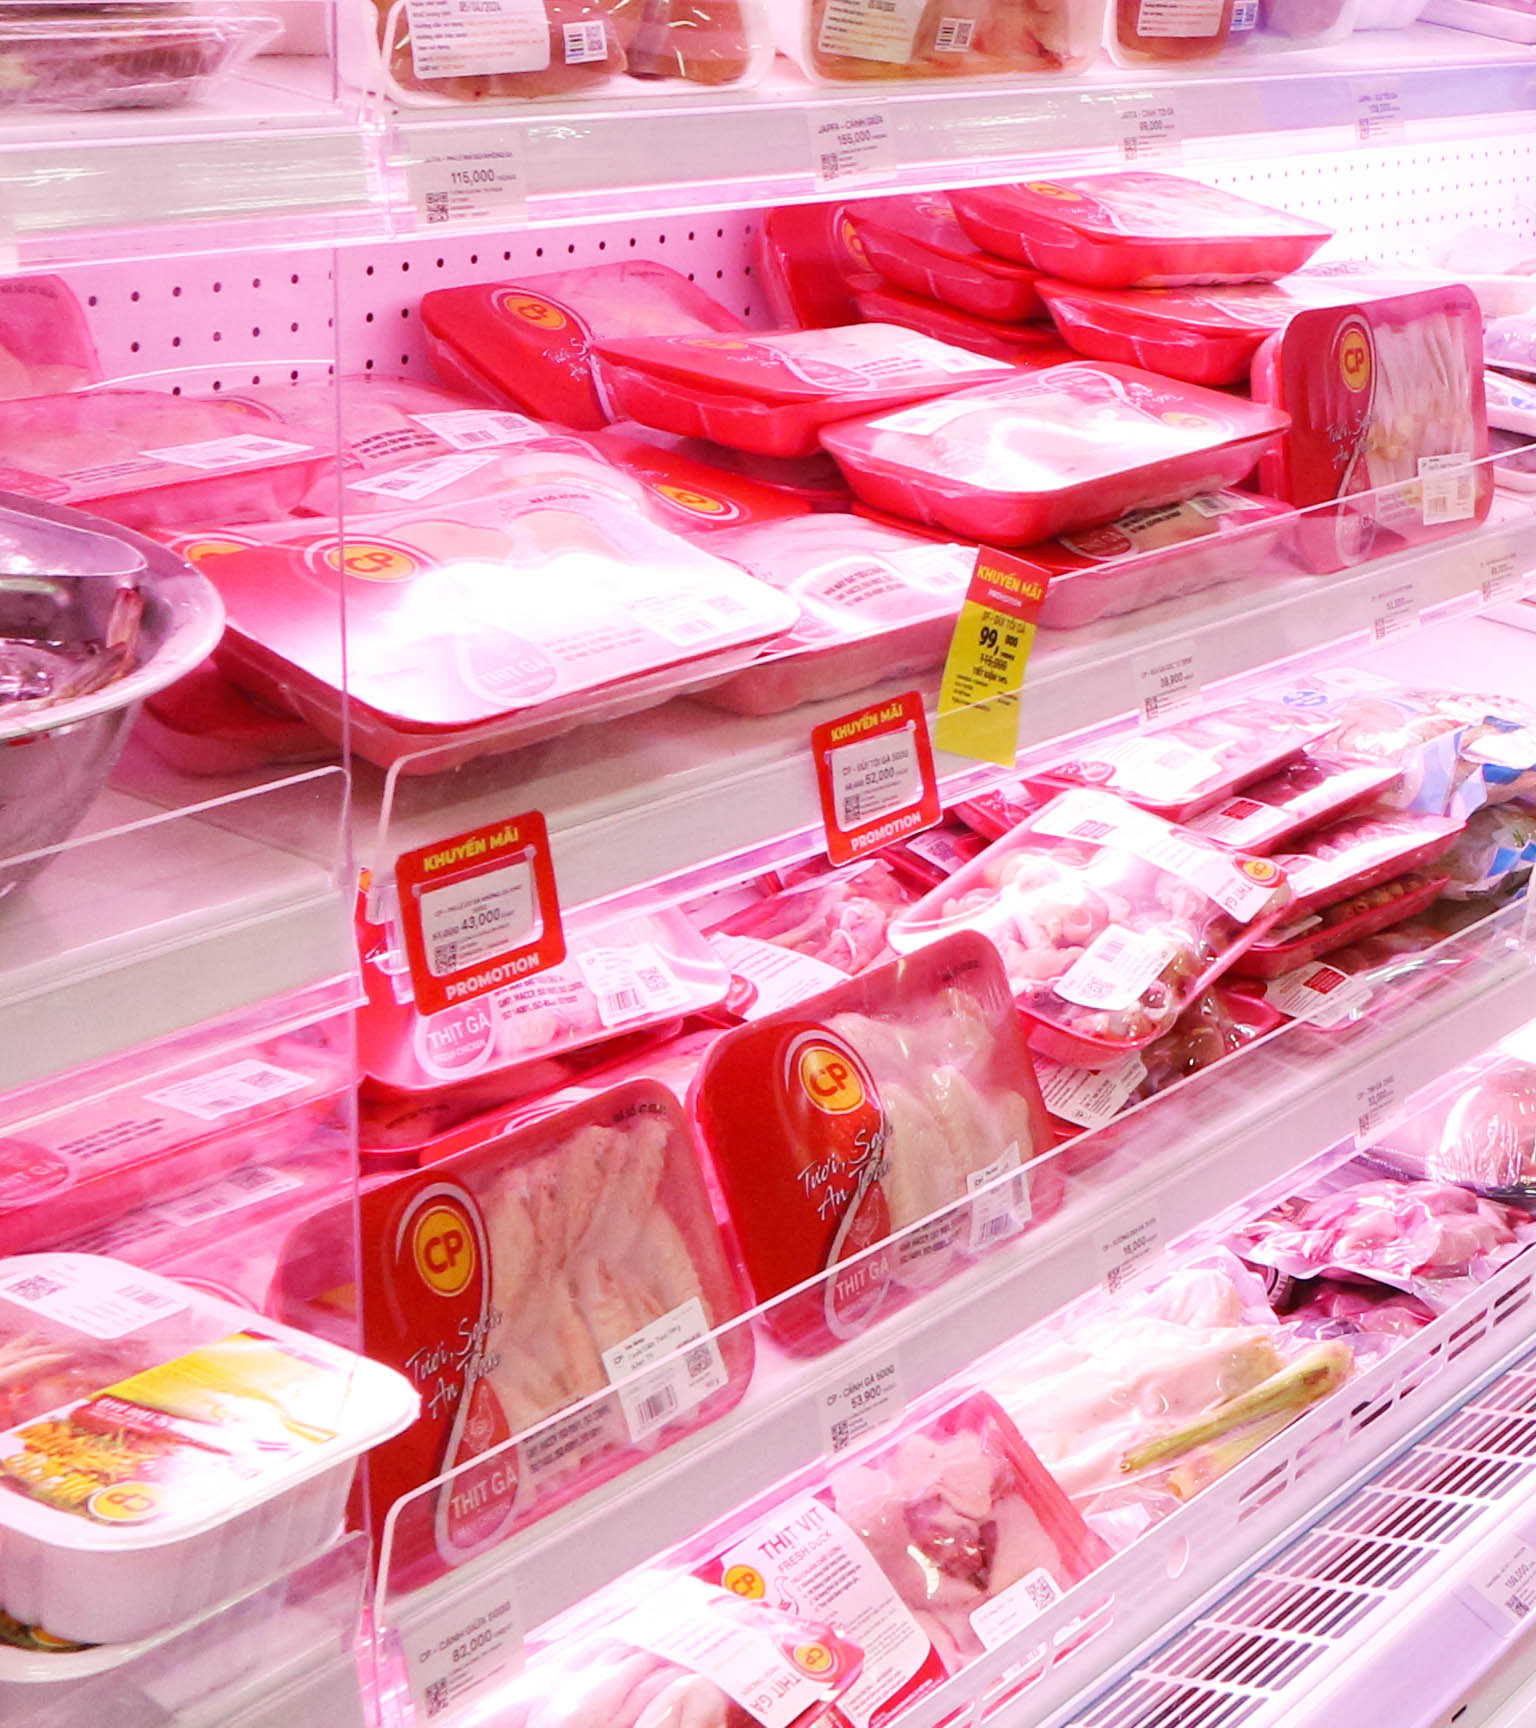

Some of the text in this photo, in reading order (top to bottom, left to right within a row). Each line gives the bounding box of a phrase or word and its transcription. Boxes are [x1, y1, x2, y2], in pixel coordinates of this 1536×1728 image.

[450, 168, 496, 186] 115,000
[517, 301, 550, 322] CP
[1343, 347, 1366, 376] CP
[343, 550, 397, 577] CP
[977, 563, 1044, 602] KHUYẾN MÃI
[830, 702, 904, 743] KHUYẾN MÃI
[423, 825, 520, 873] KHUYẾN MÃI
[850, 810, 922, 852] PROMOTION
[459, 907, 502, 932] 43,000
[445, 952, 541, 1002] PROMOTION
[426, 1007, 492, 1050] THỊT GÀ
[809, 1061, 849, 1097] CP
[422, 1227, 464, 1274] CP
[757, 1524, 800, 1562] THỊT
[730, 1573, 757, 1597] CP
